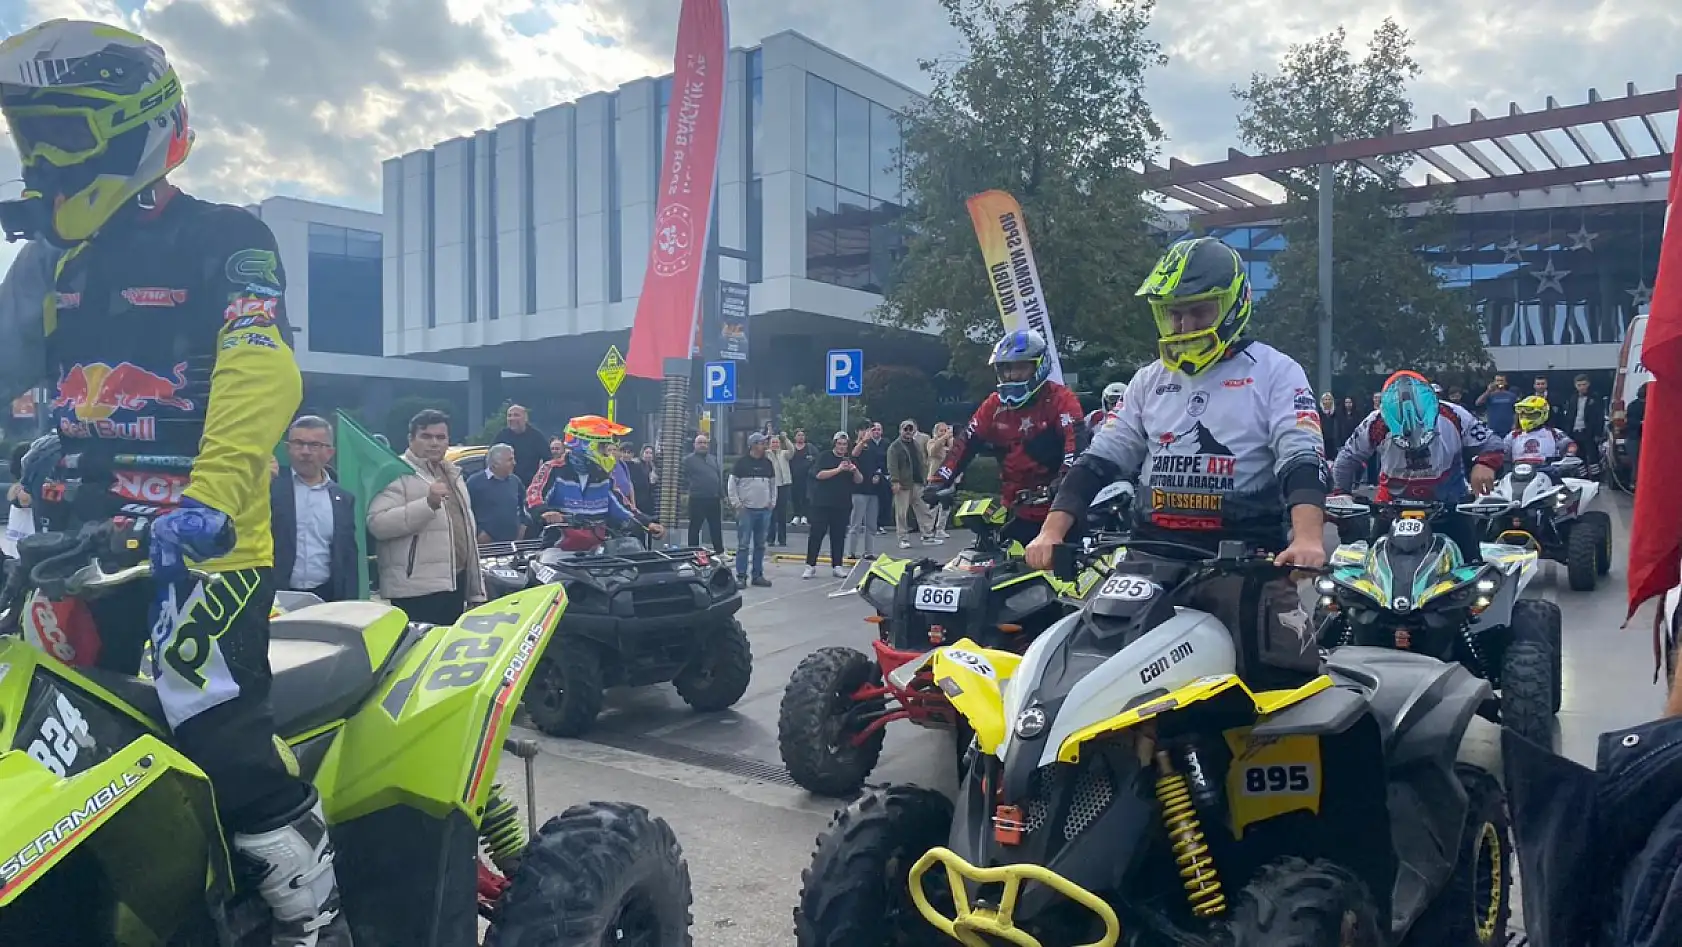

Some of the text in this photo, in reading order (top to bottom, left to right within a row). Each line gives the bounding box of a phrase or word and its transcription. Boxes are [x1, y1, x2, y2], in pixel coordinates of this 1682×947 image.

[707, 366, 726, 399] P
[829, 355, 852, 390] P
[94, 416, 155, 440] Bull
[1206, 456, 1236, 475] ATV
[1187, 475, 1234, 493] ARAÇLAR
[1167, 492, 1223, 511] TESSERACT
[1399, 522, 1421, 533] 838
[922, 588, 954, 604] 866
[1101, 579, 1147, 597] 895
[425, 612, 520, 691] 824
[503, 624, 544, 684] POLARIS
[1139, 641, 1194, 685] can am
[27, 692, 97, 779] 824
[1246, 765, 1310, 792] 895
[0, 759, 150, 880] SCRAMBLE
